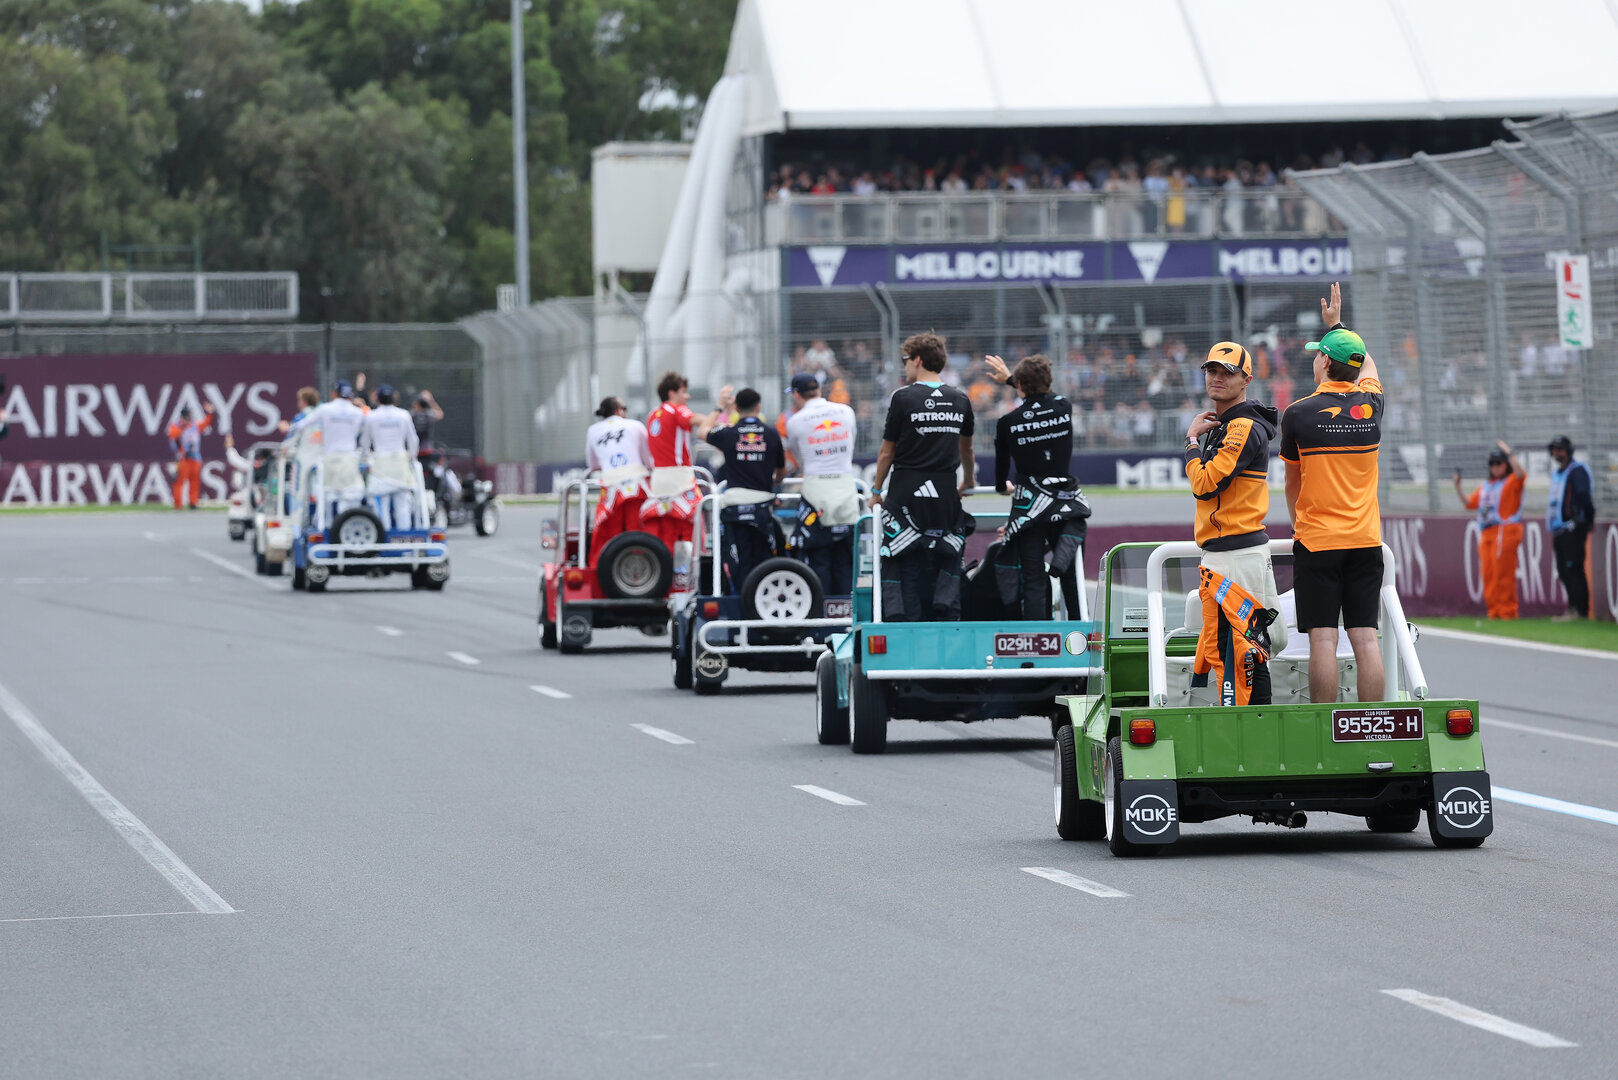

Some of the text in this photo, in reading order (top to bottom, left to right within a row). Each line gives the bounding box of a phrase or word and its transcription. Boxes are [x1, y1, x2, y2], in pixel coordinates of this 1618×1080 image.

[896, 251, 1084, 280] MELBOURNE
[1219, 247, 1351, 276] MELBOU
[1, 381, 282, 438] AIRWAYS
[911, 412, 964, 422] PETRONAS
[1010, 413, 1070, 433] PETRONAS
[3, 462, 229, 507] AIRWAS
[1125, 808, 1177, 821] MOKE
[1437, 800, 1490, 814] MOKE
